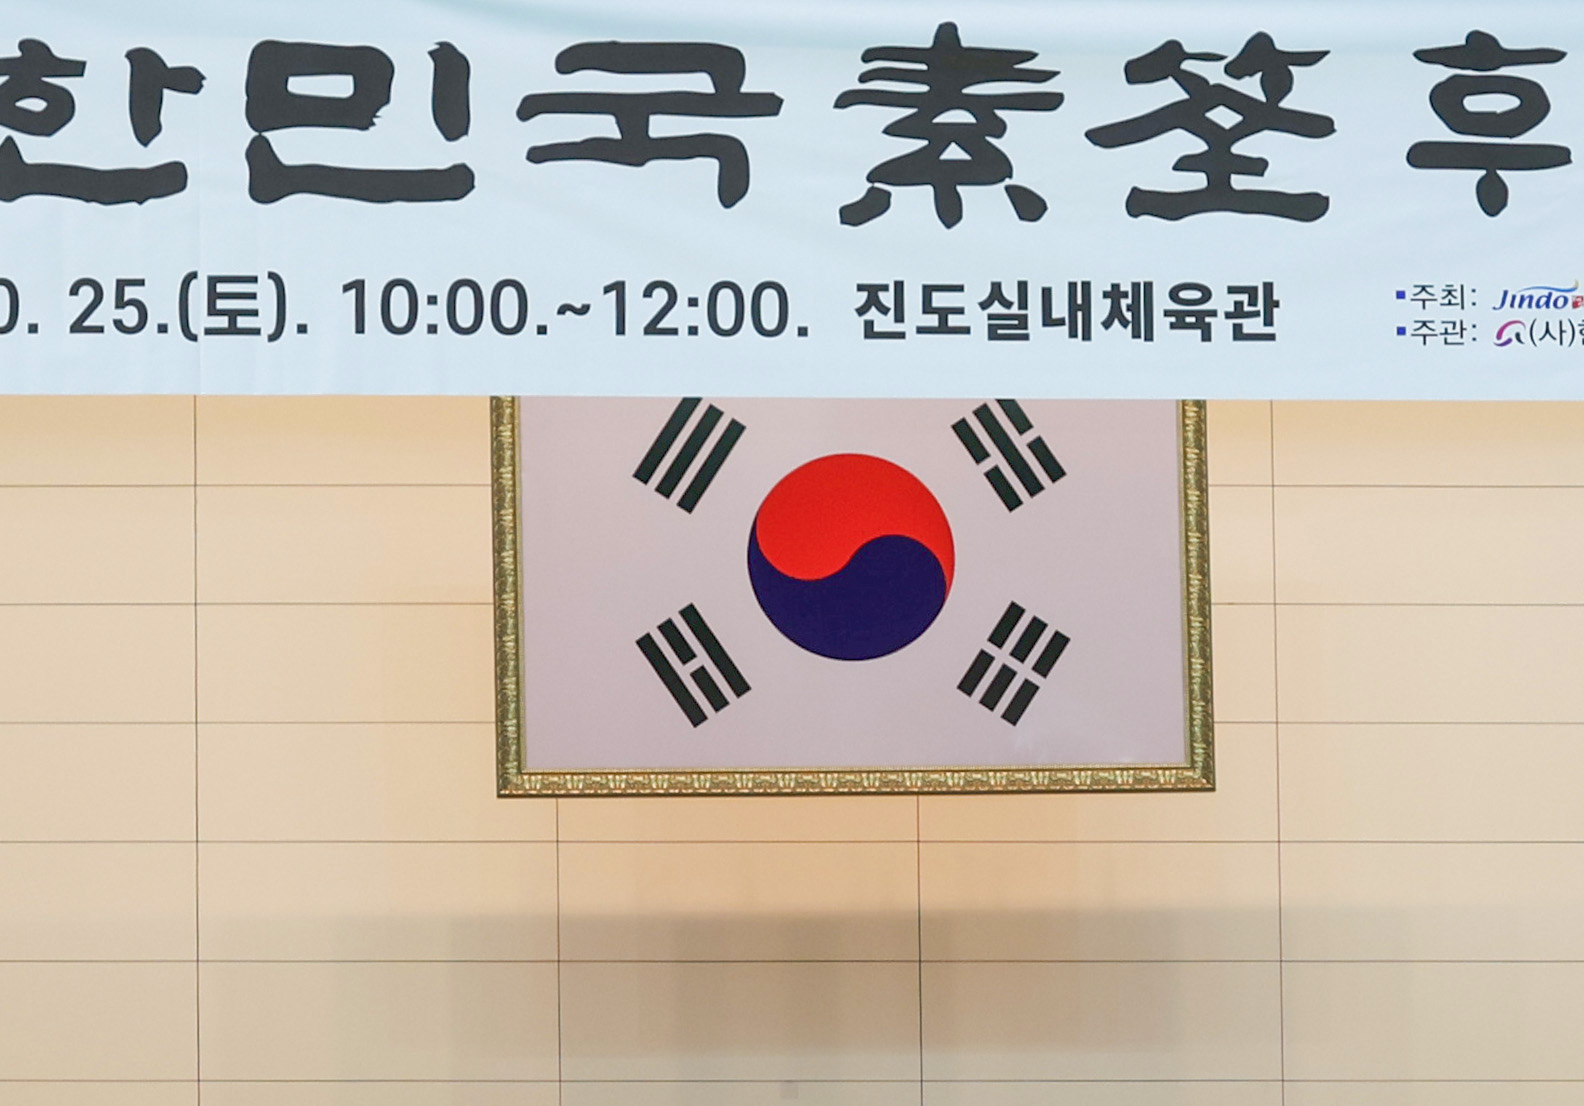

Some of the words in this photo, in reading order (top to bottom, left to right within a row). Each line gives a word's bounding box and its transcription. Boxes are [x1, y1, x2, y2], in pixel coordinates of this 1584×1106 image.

[69, 271, 308, 343] 25.(토).
[855, 280, 1280, 342] 진도실내체육관
[1410, 285, 1476, 310] 주최:
[1411, 319, 1477, 346] 주관:
